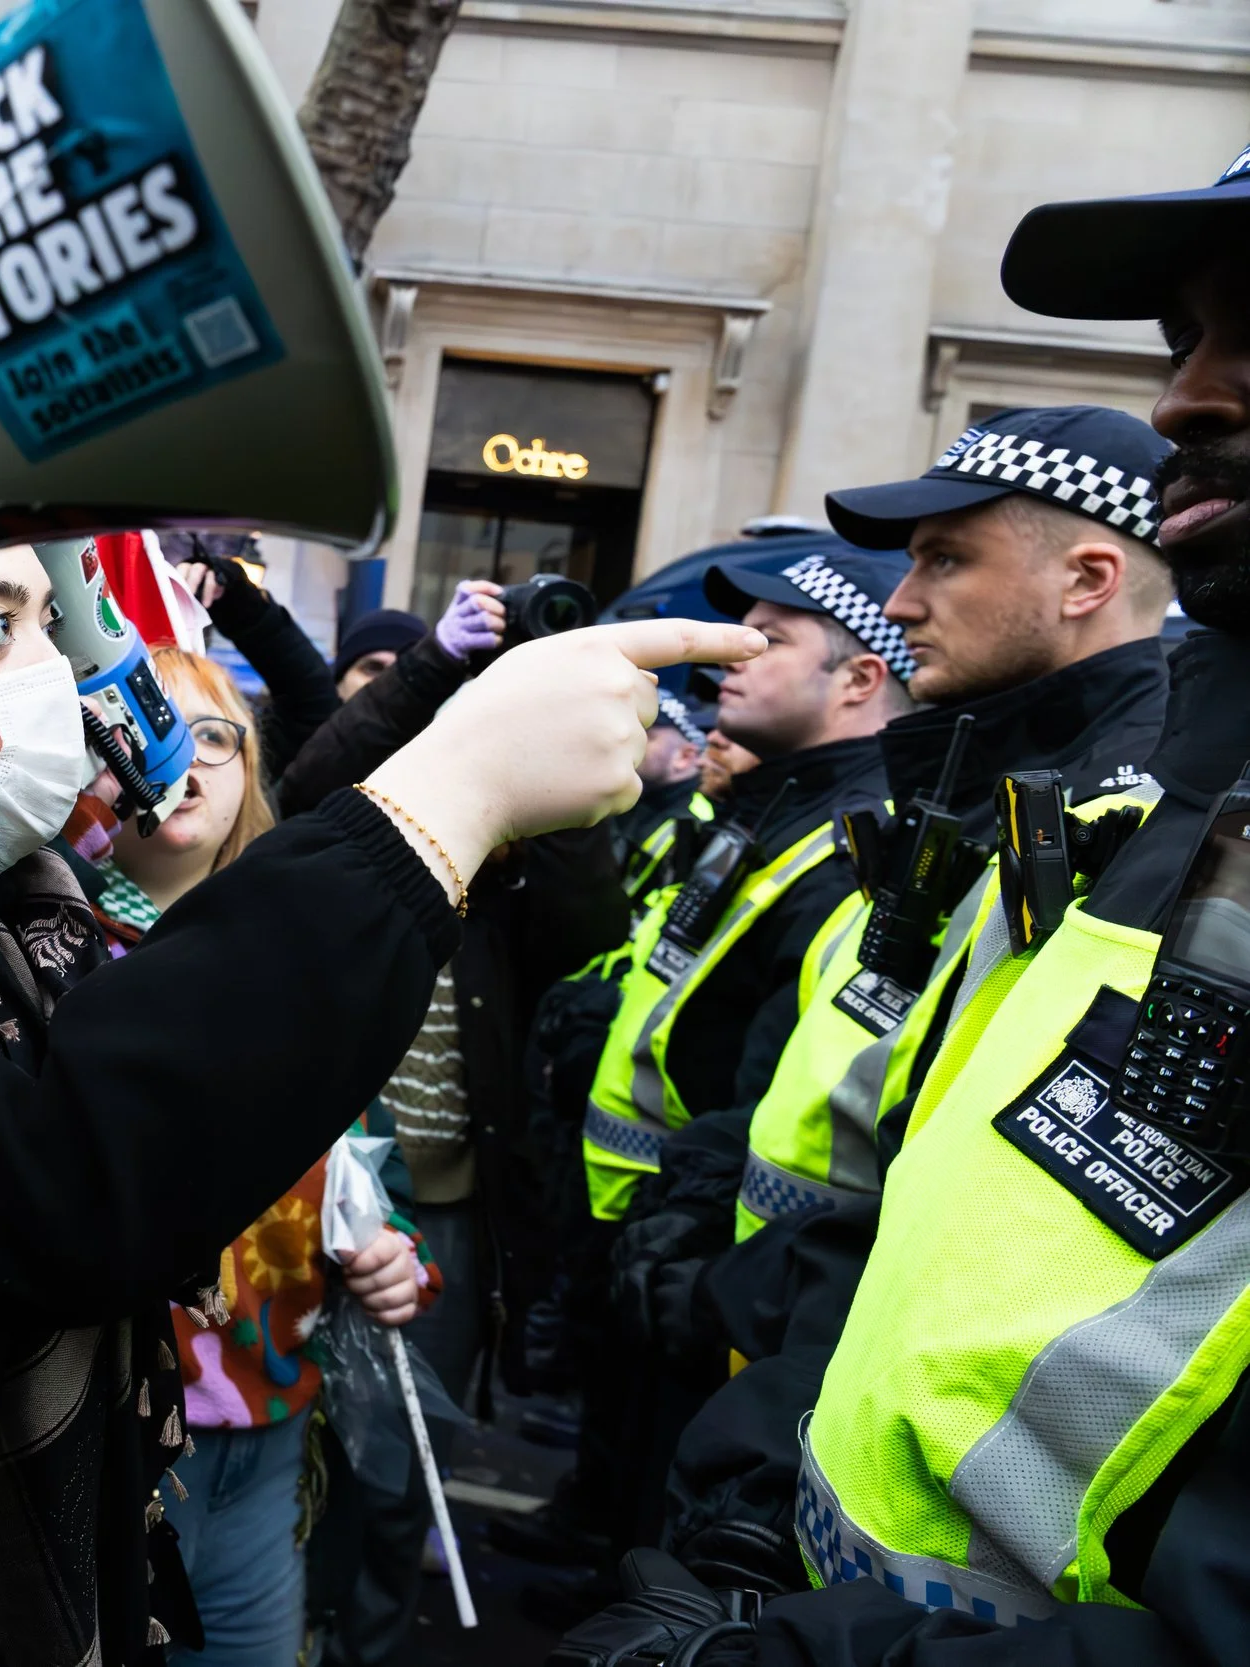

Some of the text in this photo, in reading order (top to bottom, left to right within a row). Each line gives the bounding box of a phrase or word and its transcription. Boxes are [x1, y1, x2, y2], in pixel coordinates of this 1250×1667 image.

[81, 320, 140, 363] the
[1016, 1106, 1175, 1236] POLICE OFFICER
[1111, 1129, 1188, 1190] POLICE
[1114, 1111, 1215, 1184] METROPOLITAN
